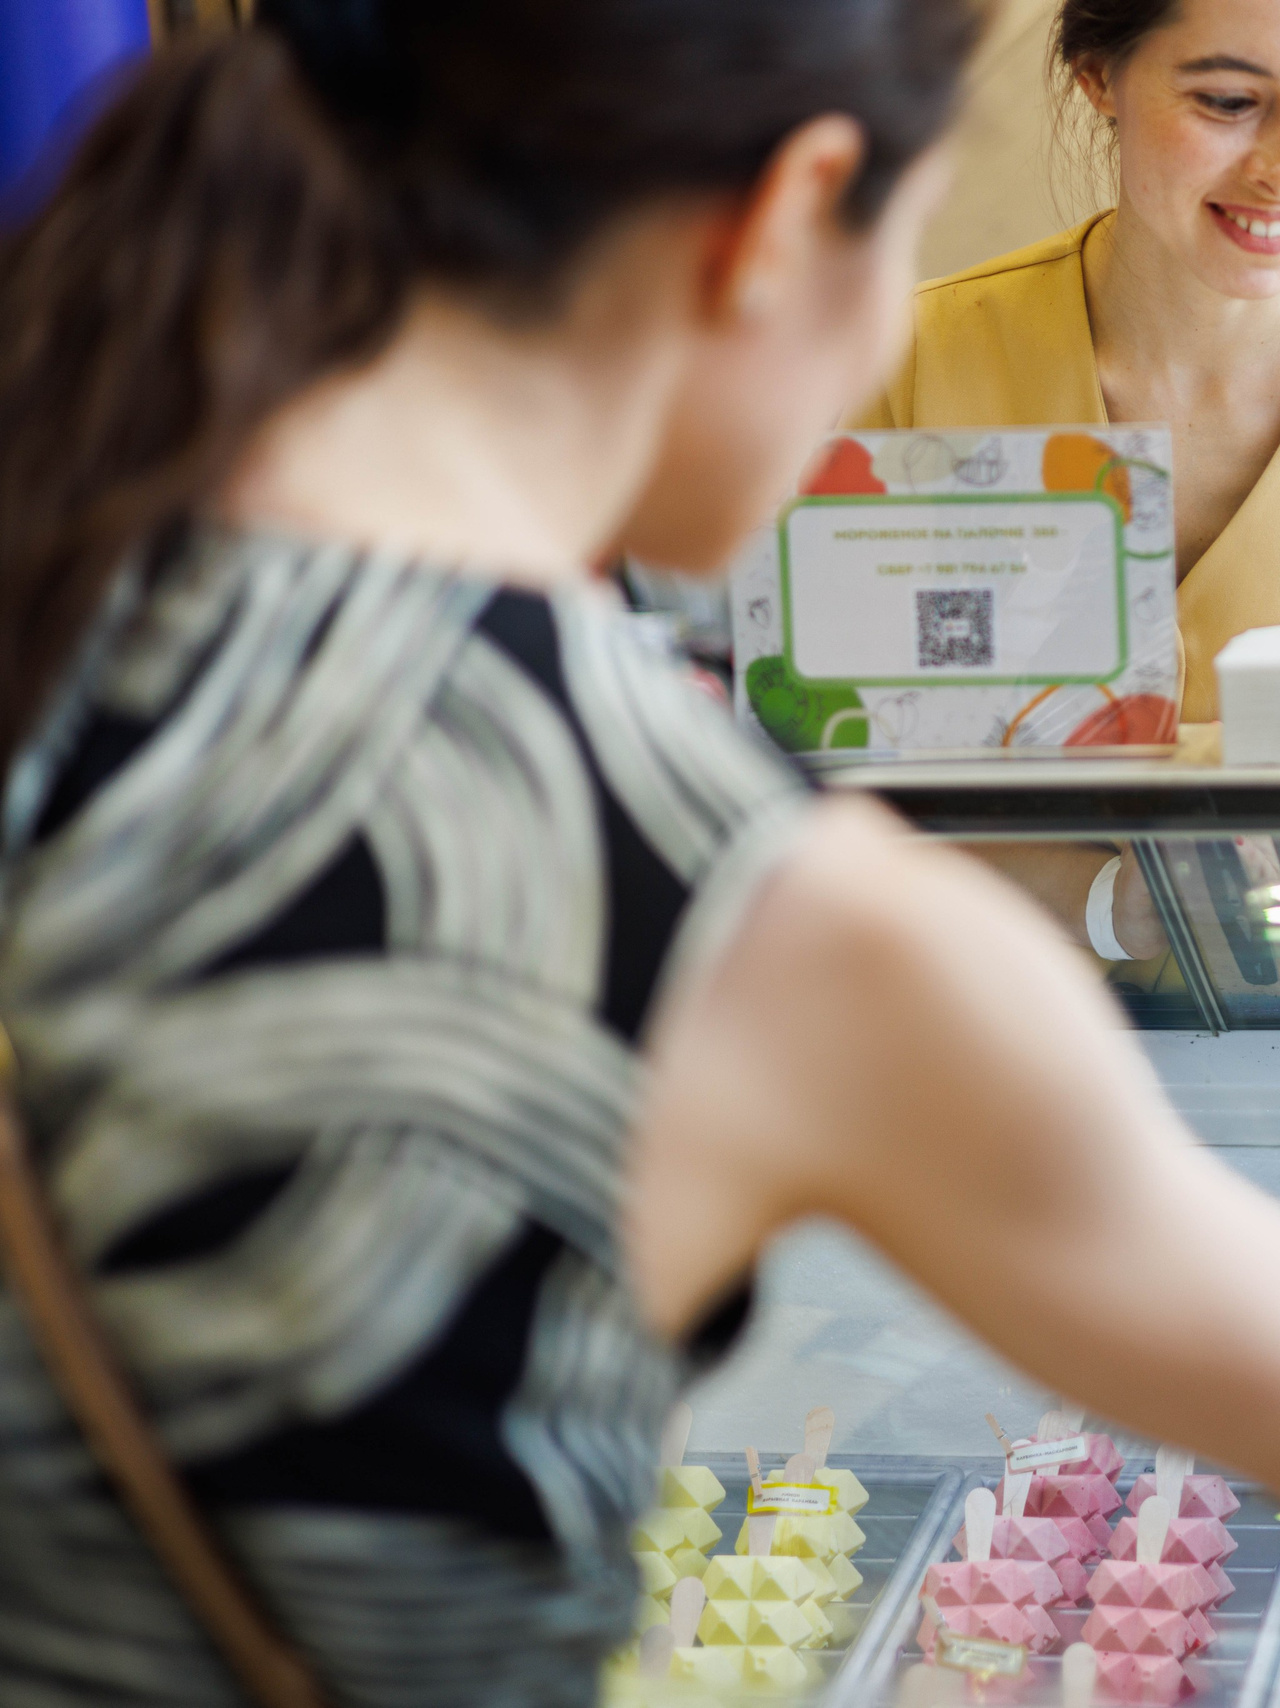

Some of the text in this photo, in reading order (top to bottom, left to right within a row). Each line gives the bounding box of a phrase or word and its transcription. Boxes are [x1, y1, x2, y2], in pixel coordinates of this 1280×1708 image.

[833, 528, 928, 541] МОРОЖЕНОЕ
[933, 527, 951, 539] НА
[958, 526, 1024, 540] ПАЛОЧКЕ
